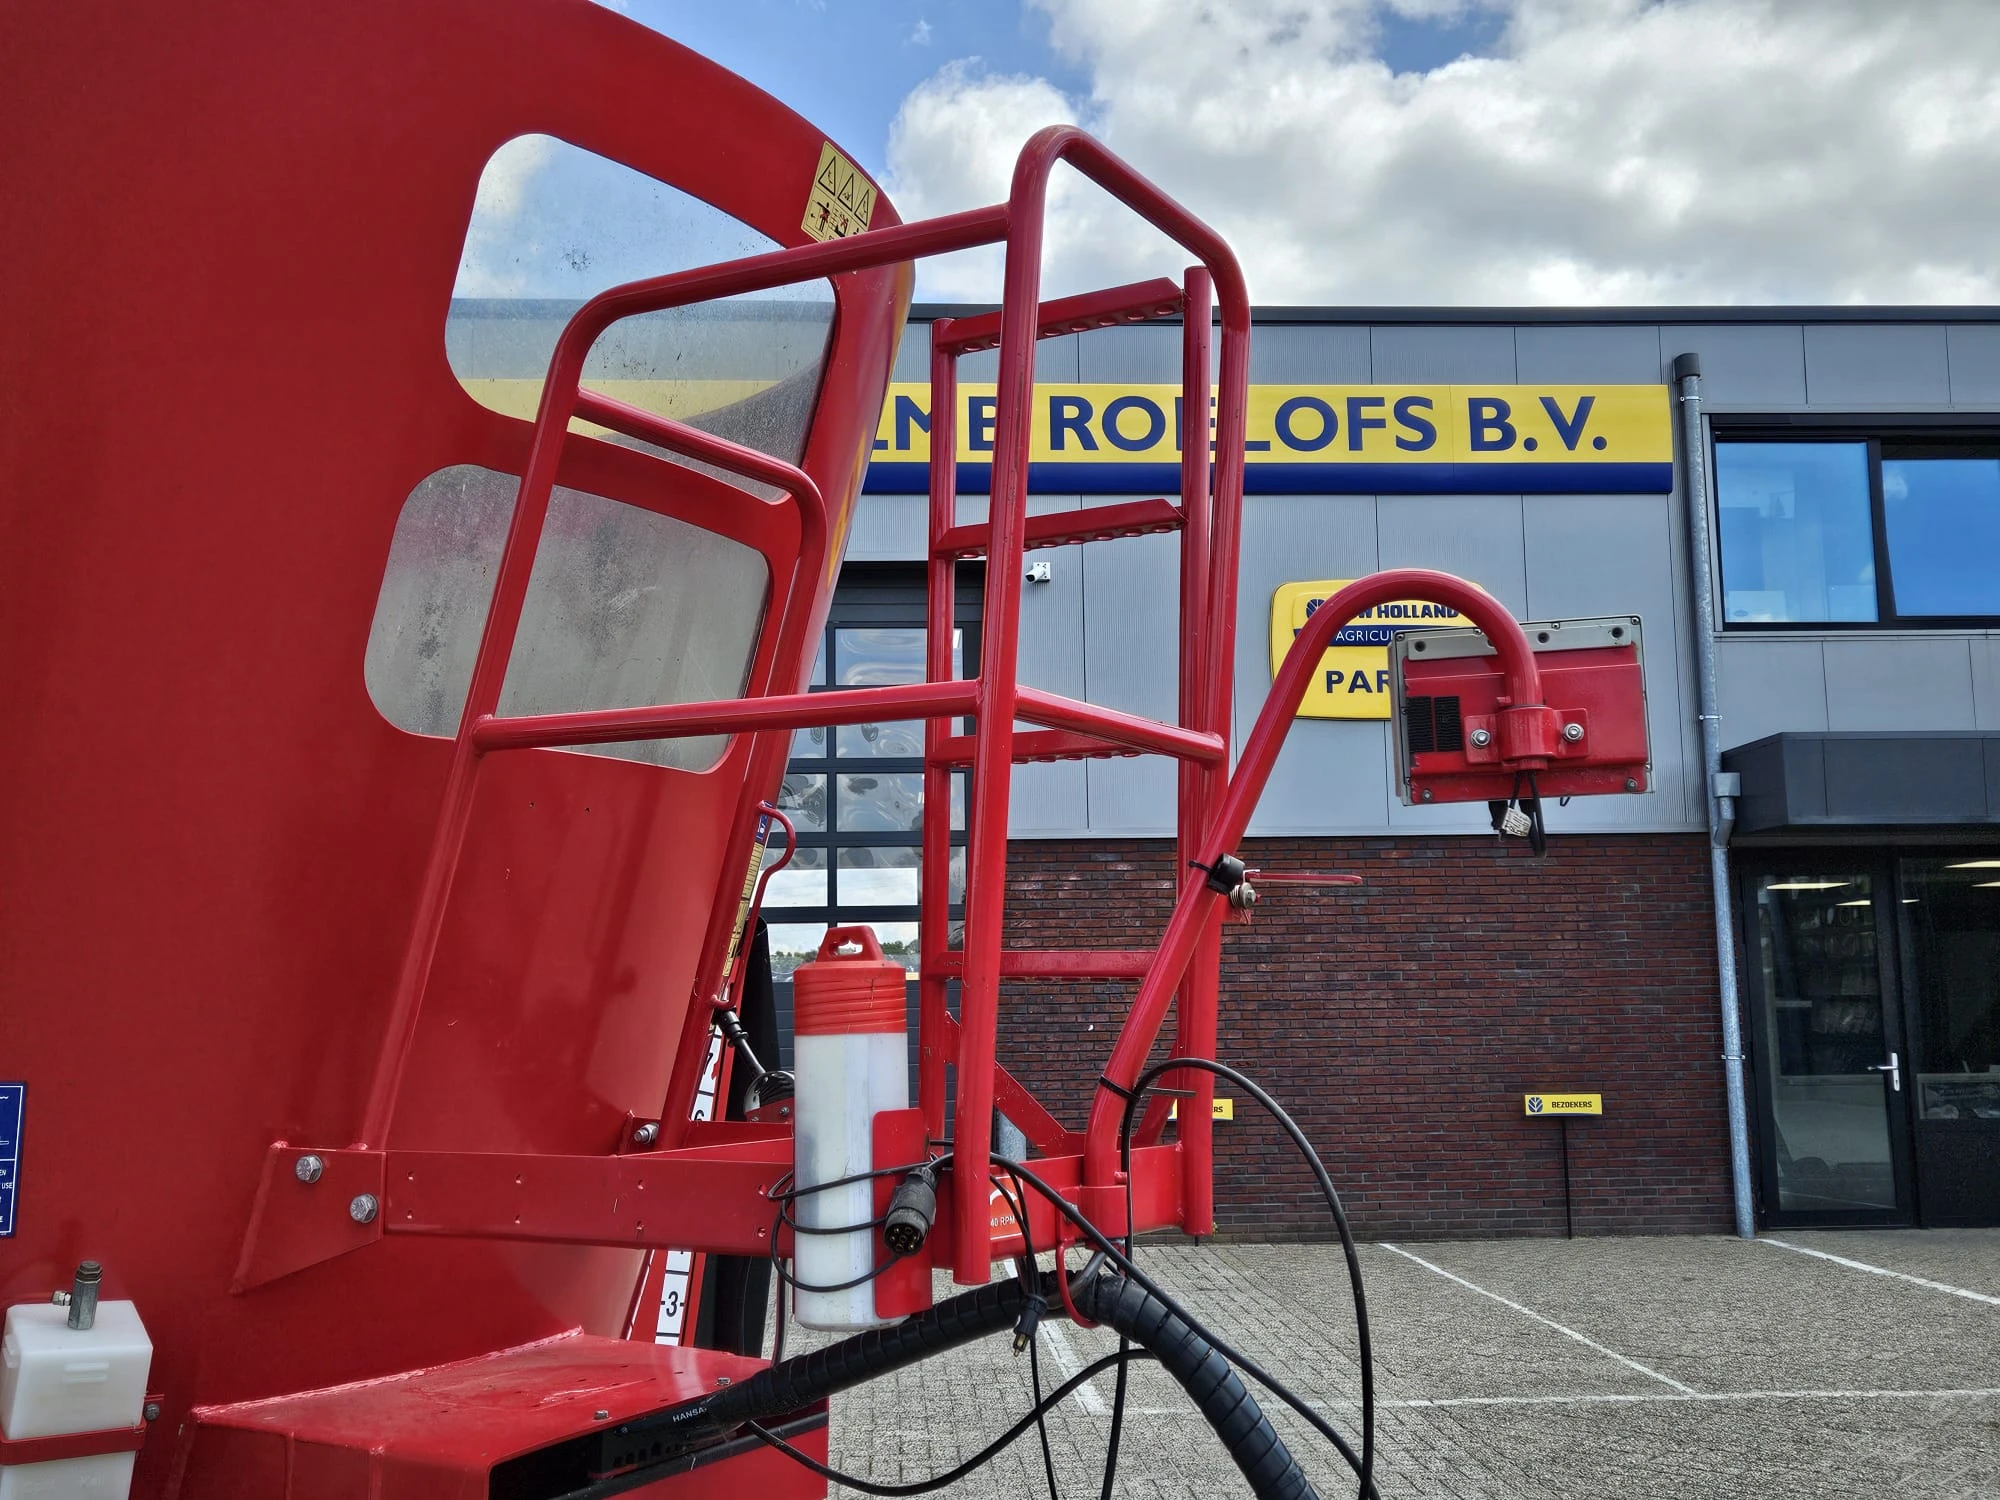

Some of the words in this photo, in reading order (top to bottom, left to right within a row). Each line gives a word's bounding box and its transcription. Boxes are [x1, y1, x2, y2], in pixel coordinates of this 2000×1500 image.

[1467, 396, 1608, 452] B.V.
[1376, 604, 1459, 619] HOLLAND
[1551, 1101, 1593, 1109] BEZOEKERS
